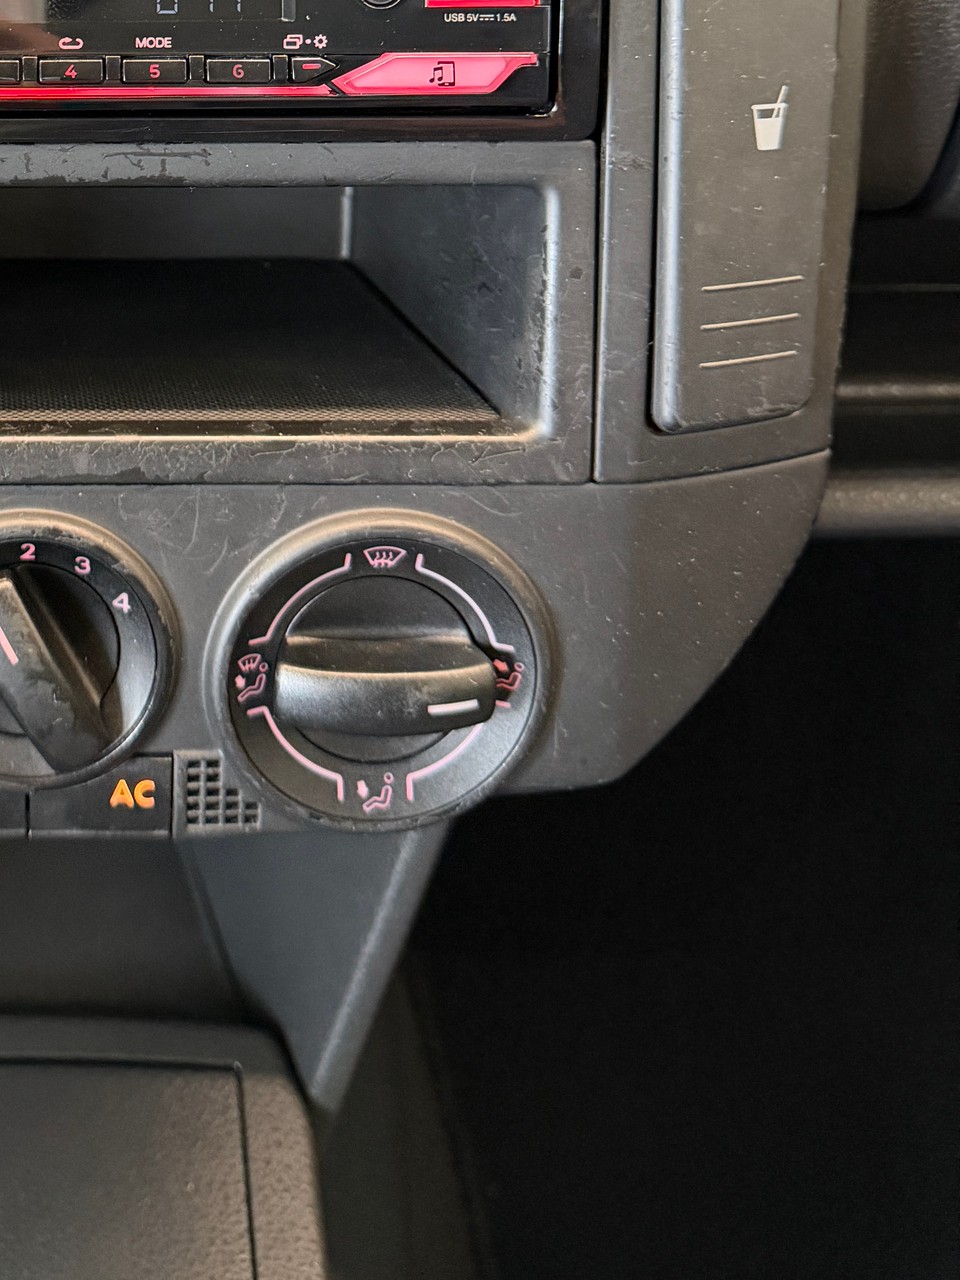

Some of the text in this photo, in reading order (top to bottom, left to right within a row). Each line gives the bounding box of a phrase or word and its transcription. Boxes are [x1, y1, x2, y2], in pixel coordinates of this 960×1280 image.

[444, 12, 465, 22] USB
[496, 12, 516, 22] 1.5A
[135, 36, 172, 48] MODE
[65, 66, 77, 78] 4
[149, 65, 160, 78] 5
[232, 65, 244, 78] 6
[19, 543, 37, 561] 2
[74, 556, 92, 575] 3
[111, 592, 131, 613] 4
[109, 778, 156, 809] AC
